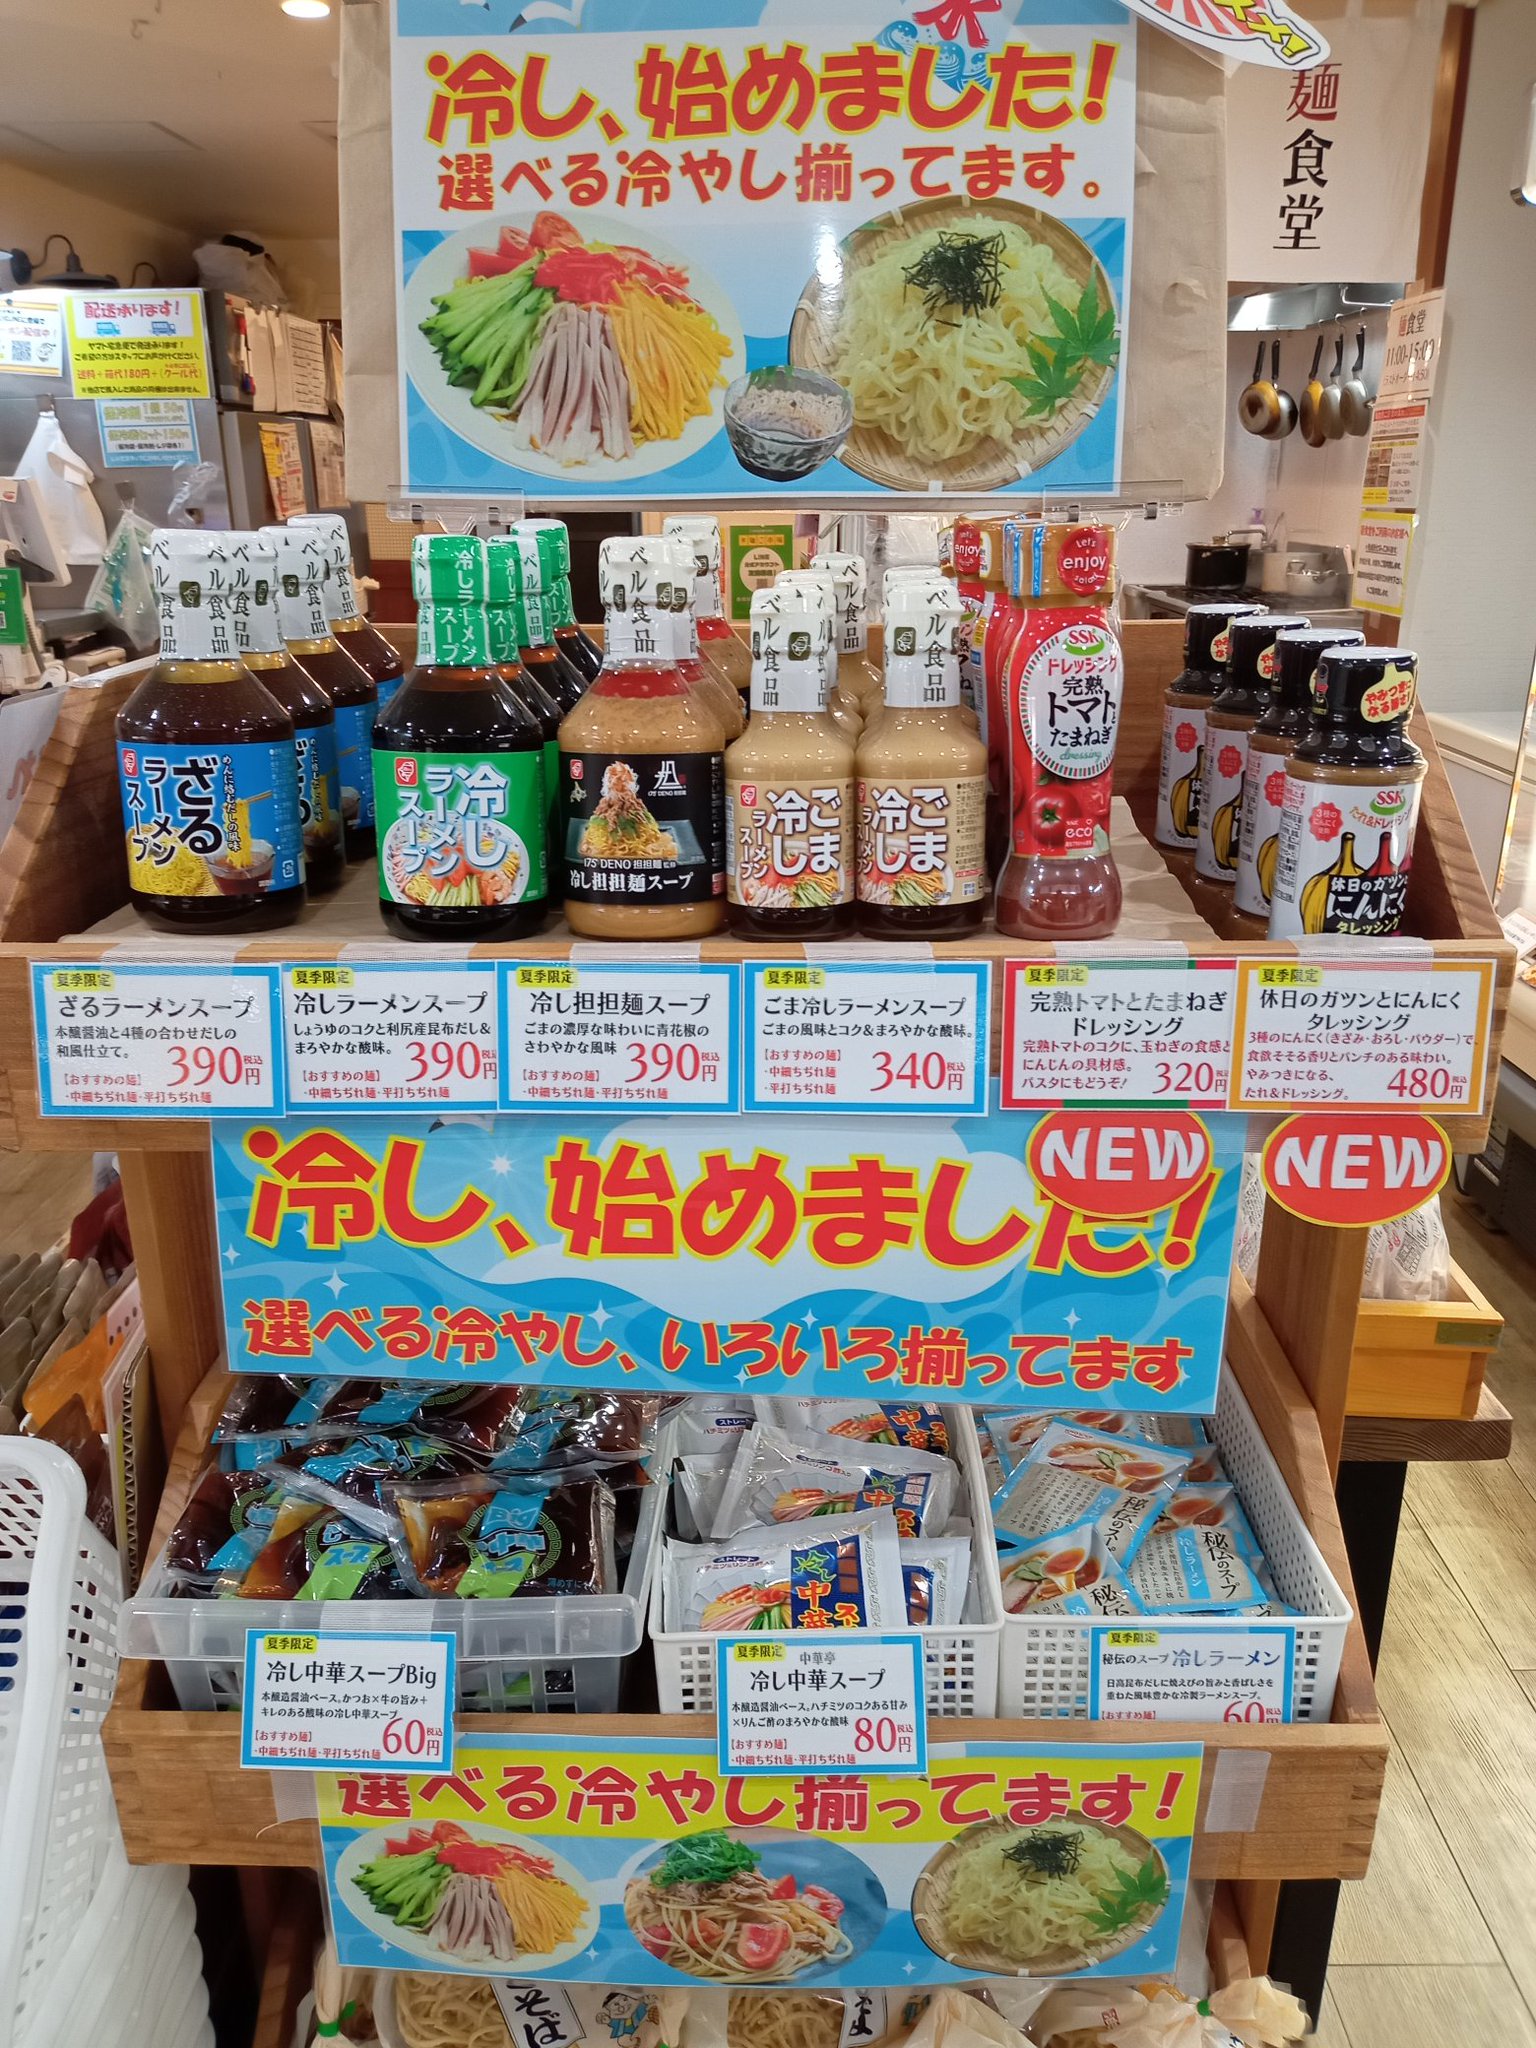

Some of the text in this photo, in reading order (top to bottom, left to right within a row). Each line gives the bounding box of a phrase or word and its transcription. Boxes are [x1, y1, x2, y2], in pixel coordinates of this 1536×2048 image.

[425, 40, 1119, 147] 冷し、始めました!
[1273, 63, 1342, 250] 麺食堂
[438, 143, 1101, 212] 選べる冷やし揃ってます。
[330, 525, 355, 614] ベル食品
[1062, 555, 1107, 571] enjoy
[152, 540, 176, 654] ベル食品
[302, 539, 326, 635] ベル食品
[524, 552, 542, 637] ベル食品
[206, 545, 229, 654] ベル食品
[630, 546, 655, 653] ベル食品
[842, 561, 859, 650] ベル食品
[440, 607, 460, 662] スープ
[924, 589, 949, 703] ベル食品
[760, 595, 781, 706] ベル食品
[1062, 675, 1104, 697] 完熟
[1050, 726, 1112, 748] たまねぎ
[143, 758, 175, 865] ラーメン
[172, 757, 223, 854] ざる
[454, 765, 508, 868] 冷し
[127, 782, 150, 862] スープ
[400, 791, 427, 874] スープ
[426, 766, 460, 876] ラーメン
[766, 788, 810, 876] 冷し
[809, 787, 842, 874] ごま
[871, 788, 910, 874] 冷し
[909, 787, 949, 873] ごま
[740, 828, 754, 880] スープ
[752, 810, 768, 879] ラーメン
[600, 859, 632, 870] DENO
[633, 860, 663, 870] 担担麺
[570, 869, 694, 893] 冷し担担麺スープ
[56, 973, 112, 987] 夏季限定
[295, 970, 350, 985] 夏季限定
[520, 969, 574, 984] 夏季限定
[767, 970, 822, 985] 夏季限定
[1029, 968, 1084, 983] 夏季限定
[1262, 968, 1319, 983] 夏季限定
[59, 995, 255, 1018] ざるラーメンスープ
[294, 991, 488, 1016] 冷しラーメンスープ
[530, 991, 711, 1016] 冷し担担麺スープ
[764, 997, 967, 1017] ごま冷しラーメンスープ
[1030, 991, 1228, 1013] 完熟トマトとたまねぎ
[1260, 989, 1462, 1009] 休日のガツンとにんにく
[294, 1022, 491, 1037] しょうゆのコクと利尻産昆布だし&
[525, 1022, 709, 1037] ごまの濃厚な味わいに青花椒の
[762, 1023, 973, 1038] ごまの風味とコク&まろやかな酸味。
[1073, 1017, 1184, 1037] ドレッシング
[1307, 1013, 1411, 1031] タレッシング
[56, 1044, 129, 1059] 和風仕立て。
[295, 1040, 392, 1055] まろやかな酸味。
[524, 1041, 617, 1055] さわやかな風味
[1023, 1040, 1230, 1053] 完熟トマトのコクに、玉ねぎの食感と
[1247, 1050, 1452, 1064] 食欲そそる香りとパンチのある味わい。
[1023, 1059, 1132, 1072] にんじんの具材感。
[1247, 1069, 1334, 1081] やみつきになる、
[1022, 1077, 1127, 1090] パスタにもどうぞ!
[1245, 1087, 1350, 1100] たれ&ドレッシング。
[1039, 1127, 1206, 1182] NEW
[1274, 1133, 1444, 1190] NEW
[242, 1125, 1222, 1280] 冷し、始めました!
[241, 1297, 1196, 1395] 選べる冷やし、いろいろ揃ってます
[1202, 1530, 1241, 1599] 秘伝のスープ
[267, 1637, 314, 1650] 夏季限定
[1110, 1632, 1156, 1644] 夏季限定
[737, 1645, 783, 1658] 夏季限定
[799, 1652, 836, 1665] 中華亭
[1102, 1648, 1281, 1668] 秘伝のスープ 冷しラーメン
[266, 1660, 437, 1689] 冷し中華スープBig
[750, 1668, 886, 1692] 冷し中華スープ
[260, 1707, 398, 1720] キレのある酸味の冷し中華スープ
[338, 1765, 1186, 1835] 選べる冷やし揃ってます!
